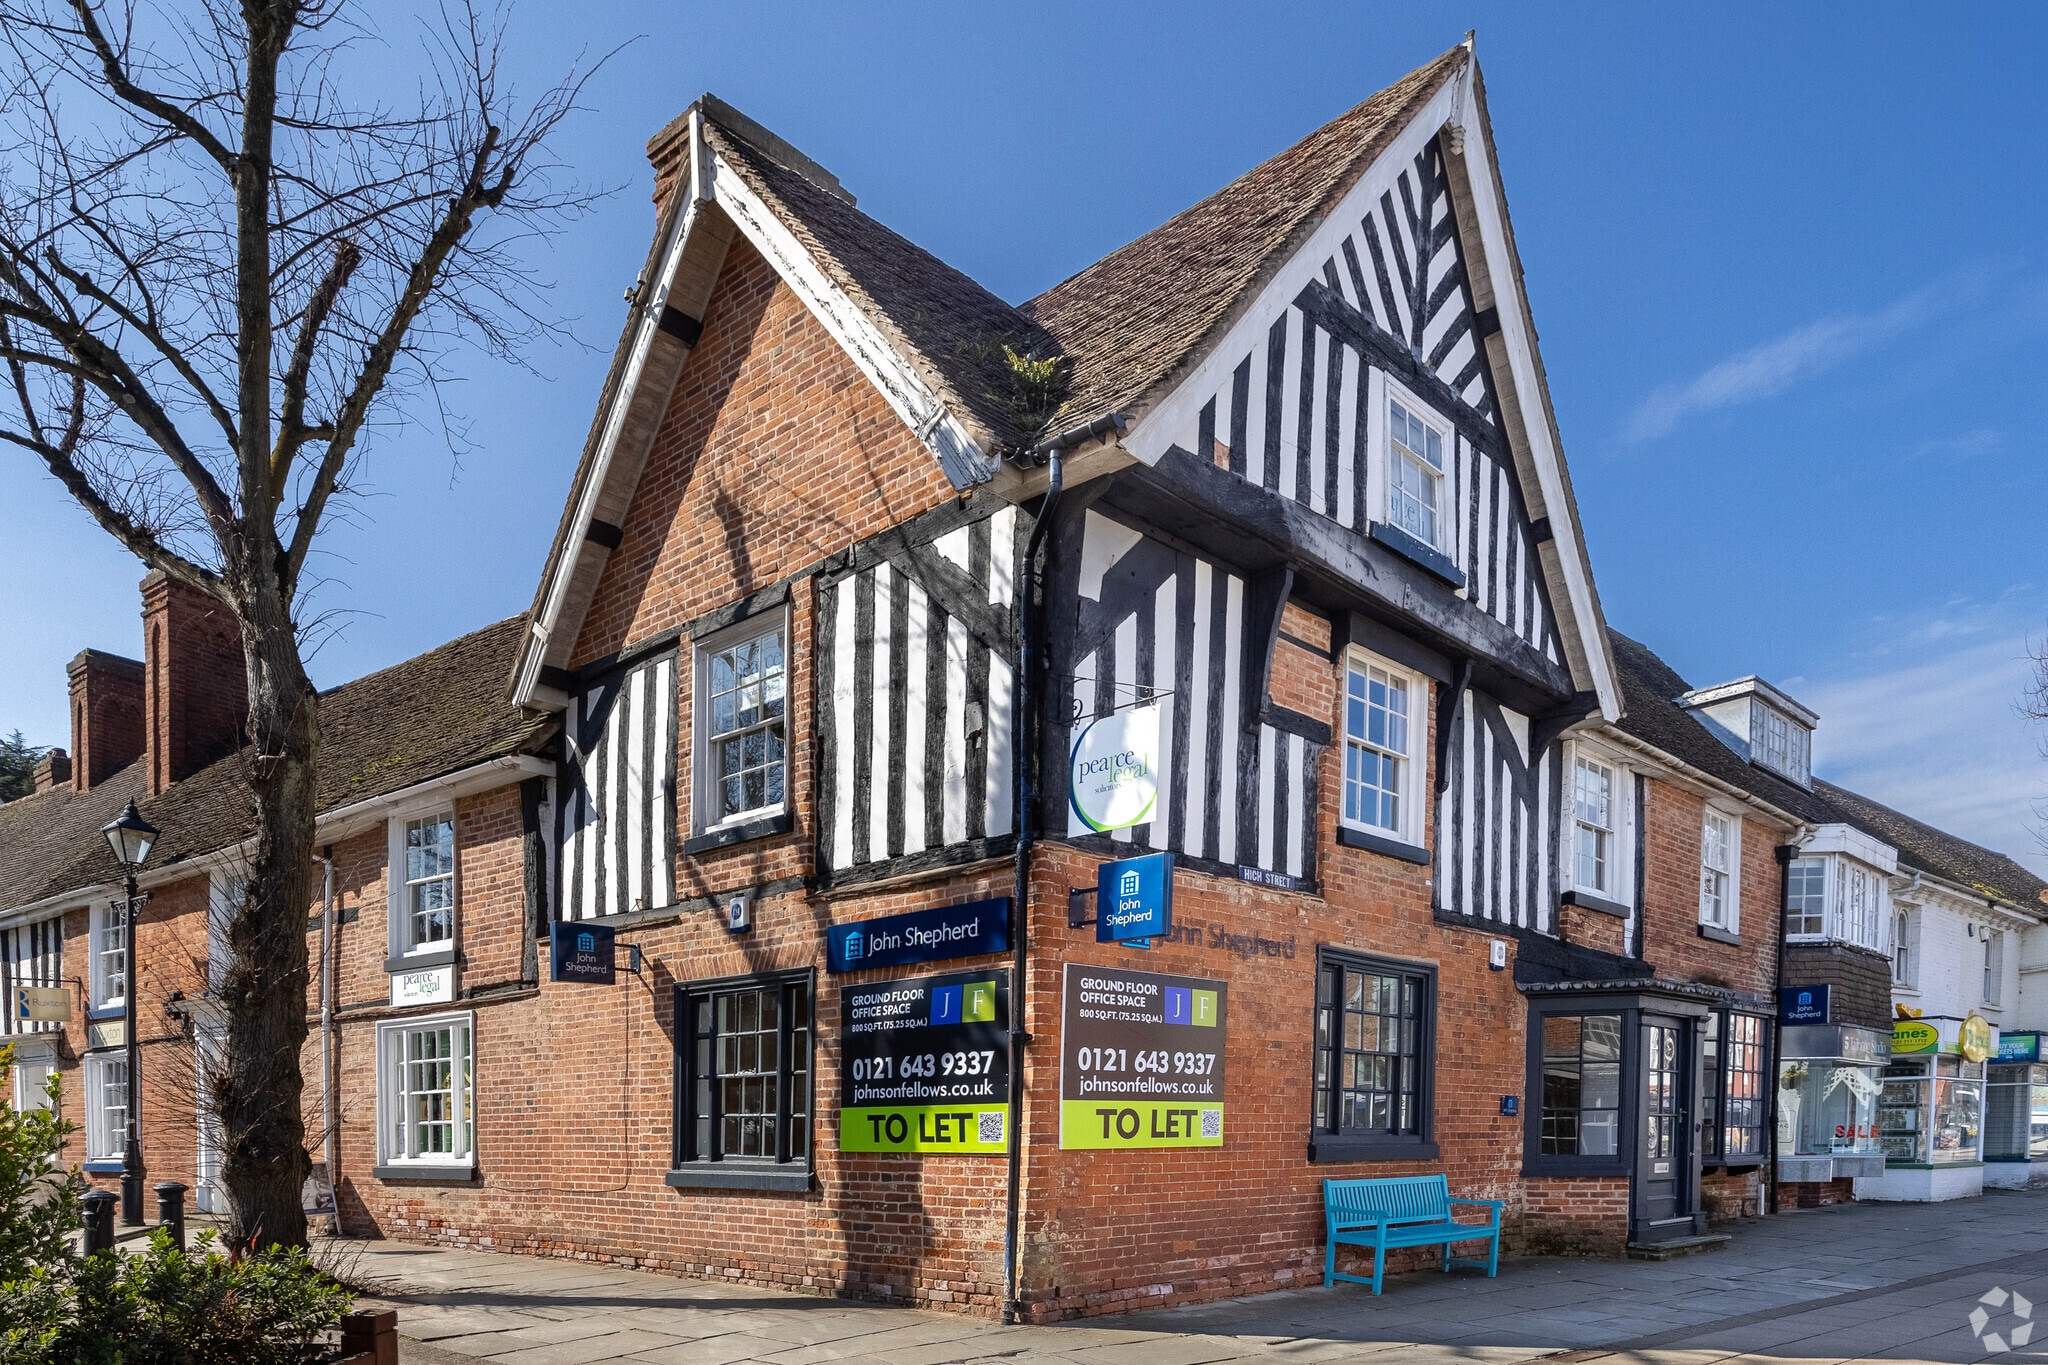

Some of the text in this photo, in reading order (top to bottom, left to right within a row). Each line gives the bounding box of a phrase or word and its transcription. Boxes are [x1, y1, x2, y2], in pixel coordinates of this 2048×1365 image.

[1078, 750, 1134, 784] pearce
[1108, 753, 1148, 783] legal
[1244, 868, 1291, 889] HIGH STREET
[1118, 898, 1140, 914] John
[1106, 908, 1152, 927] Shepherd
[868, 917, 980, 957] John Shepherd
[1208, 922, 1296, 960] Shepherd
[565, 961, 607, 974] Shepherd
[576, 952, 597, 964] John
[403, 972, 433, 990] pearce
[419, 975, 440, 997] legal
[1080, 977, 1158, 996] GROUND FLOOR
[32, 997, 67, 1008] Ruxton
[852, 988, 925, 1007] GROUND FLOOR
[1080, 991, 1146, 1008] OFFICE SPACE
[852, 1003, 912, 1019] OFFICE SPACE
[1079, 1009, 1163, 1024] 800 SQ.FT. (75.25 SQ.M.)
[1788, 1010, 1821, 1020] Shepherd
[1797, 1005, 1813, 1013] John
[851, 1017, 928, 1032] 800 SQ.FT. (75.25 SQ.M.)
[852, 1050, 995, 1081] 0121 643 9337
[1078, 1046, 1216, 1075] 0121 643 9337
[853, 1078, 994, 1104] johnsonfellows.co.uk
[1079, 1075, 1214, 1096] johnsonfellows.co.uk
[867, 1112, 974, 1144] TO LET
[1095, 1108, 1198, 1140] TO LET
[1835, 1124, 1881, 1139] SALE
